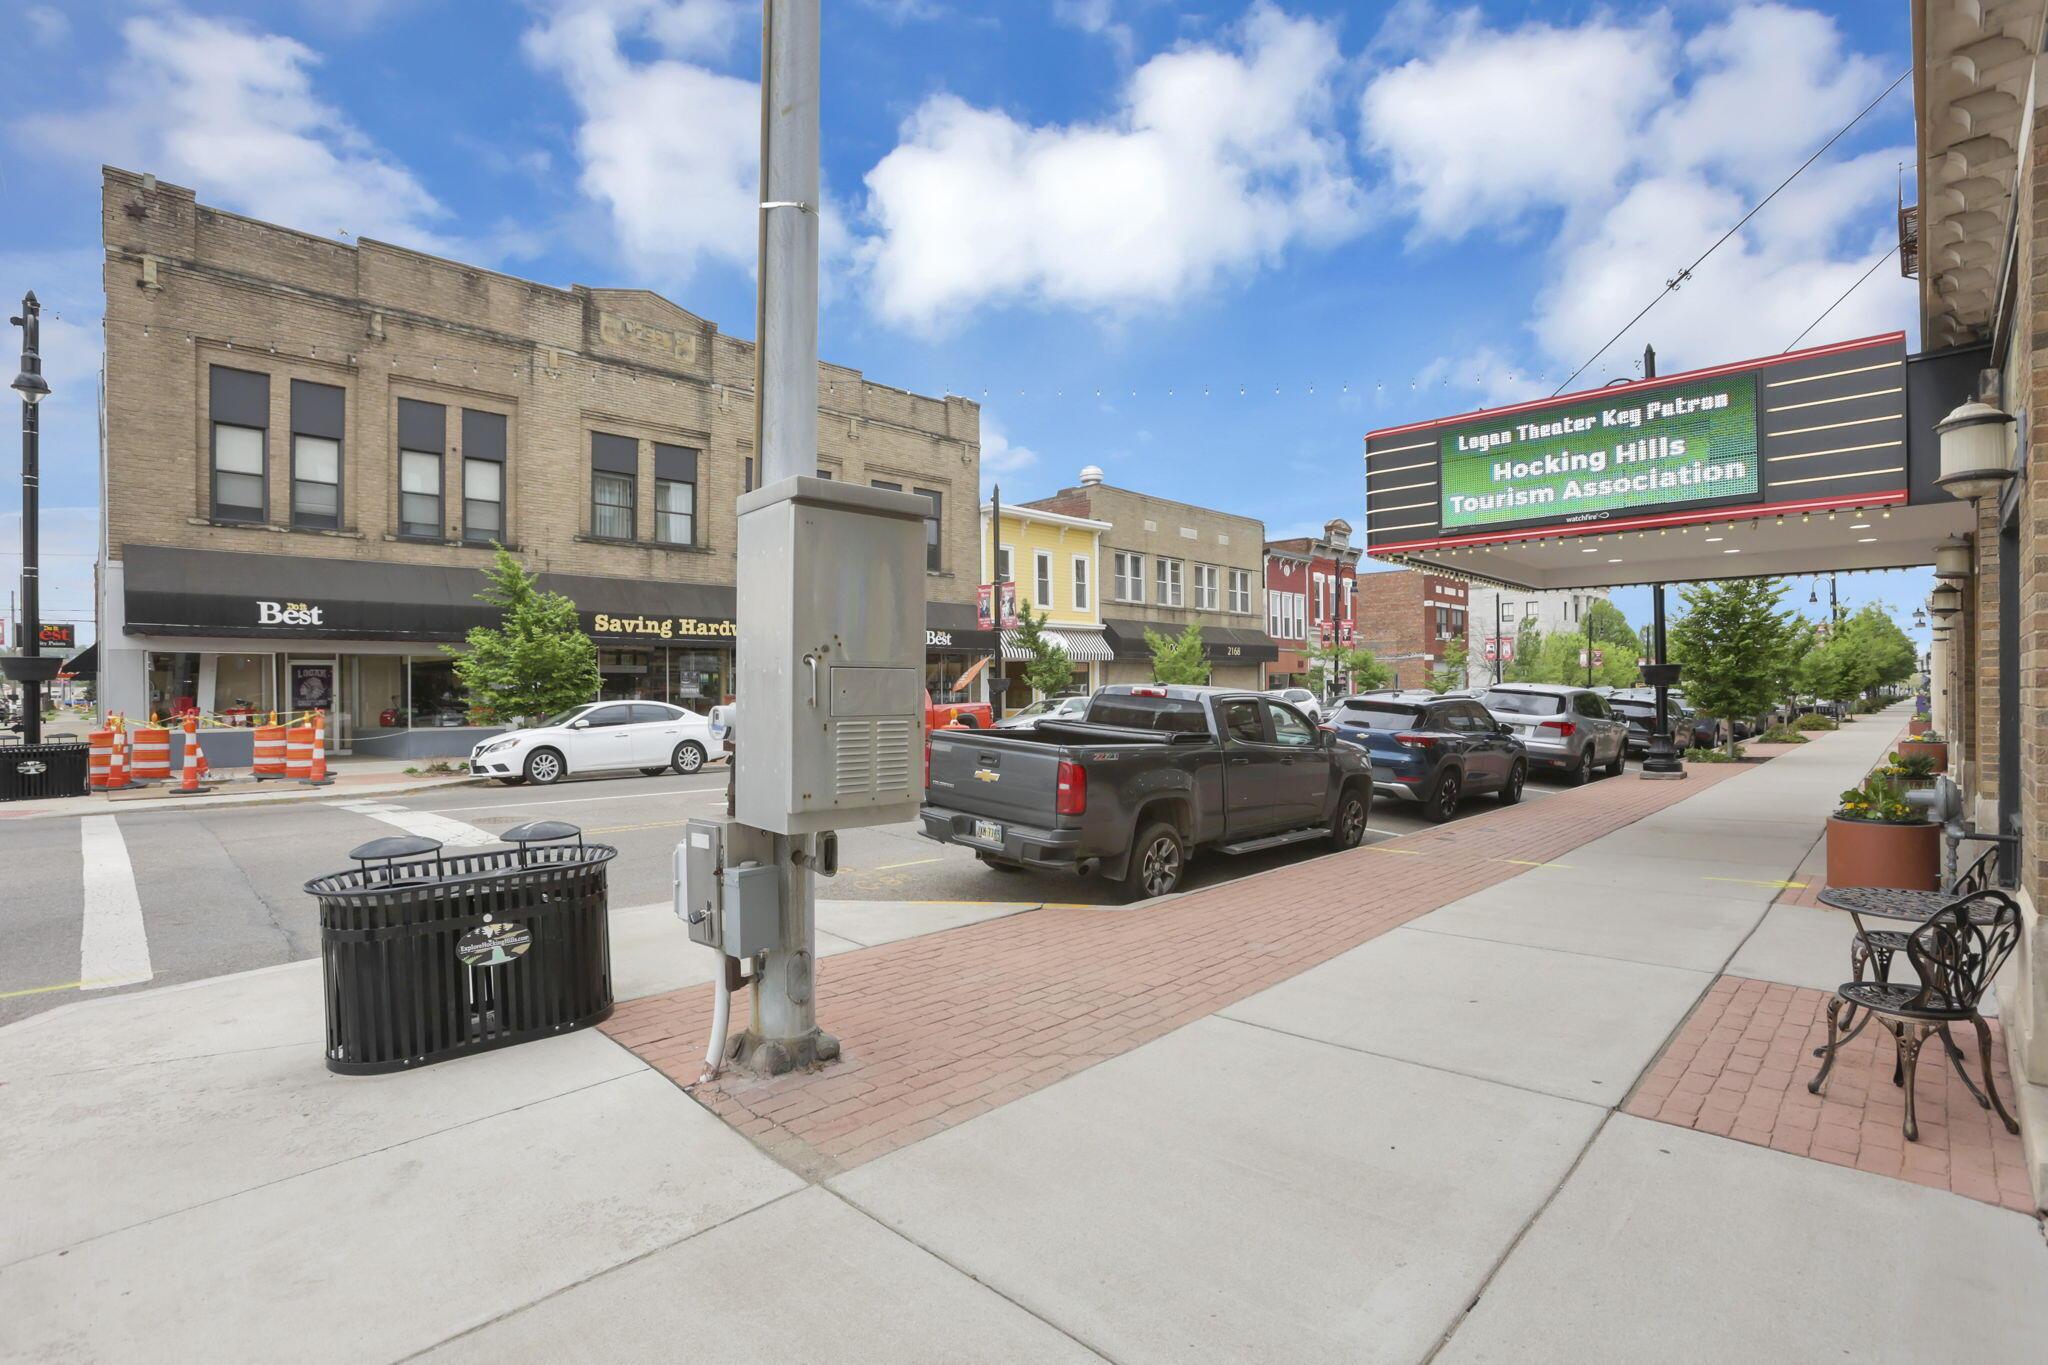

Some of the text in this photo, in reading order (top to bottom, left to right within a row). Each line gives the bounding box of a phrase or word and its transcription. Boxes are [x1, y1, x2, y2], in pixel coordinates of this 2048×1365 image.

[1458, 393, 1729, 452] Logan Theater Key Patron
[1493, 436, 1686, 482] Hocking Hills
[1450, 460, 1746, 514] Tourism Association
[256, 601, 323, 625] Best
[39, 629, 70, 641] est
[594, 614, 673, 639] Saving
[925, 630, 952, 646] Best
